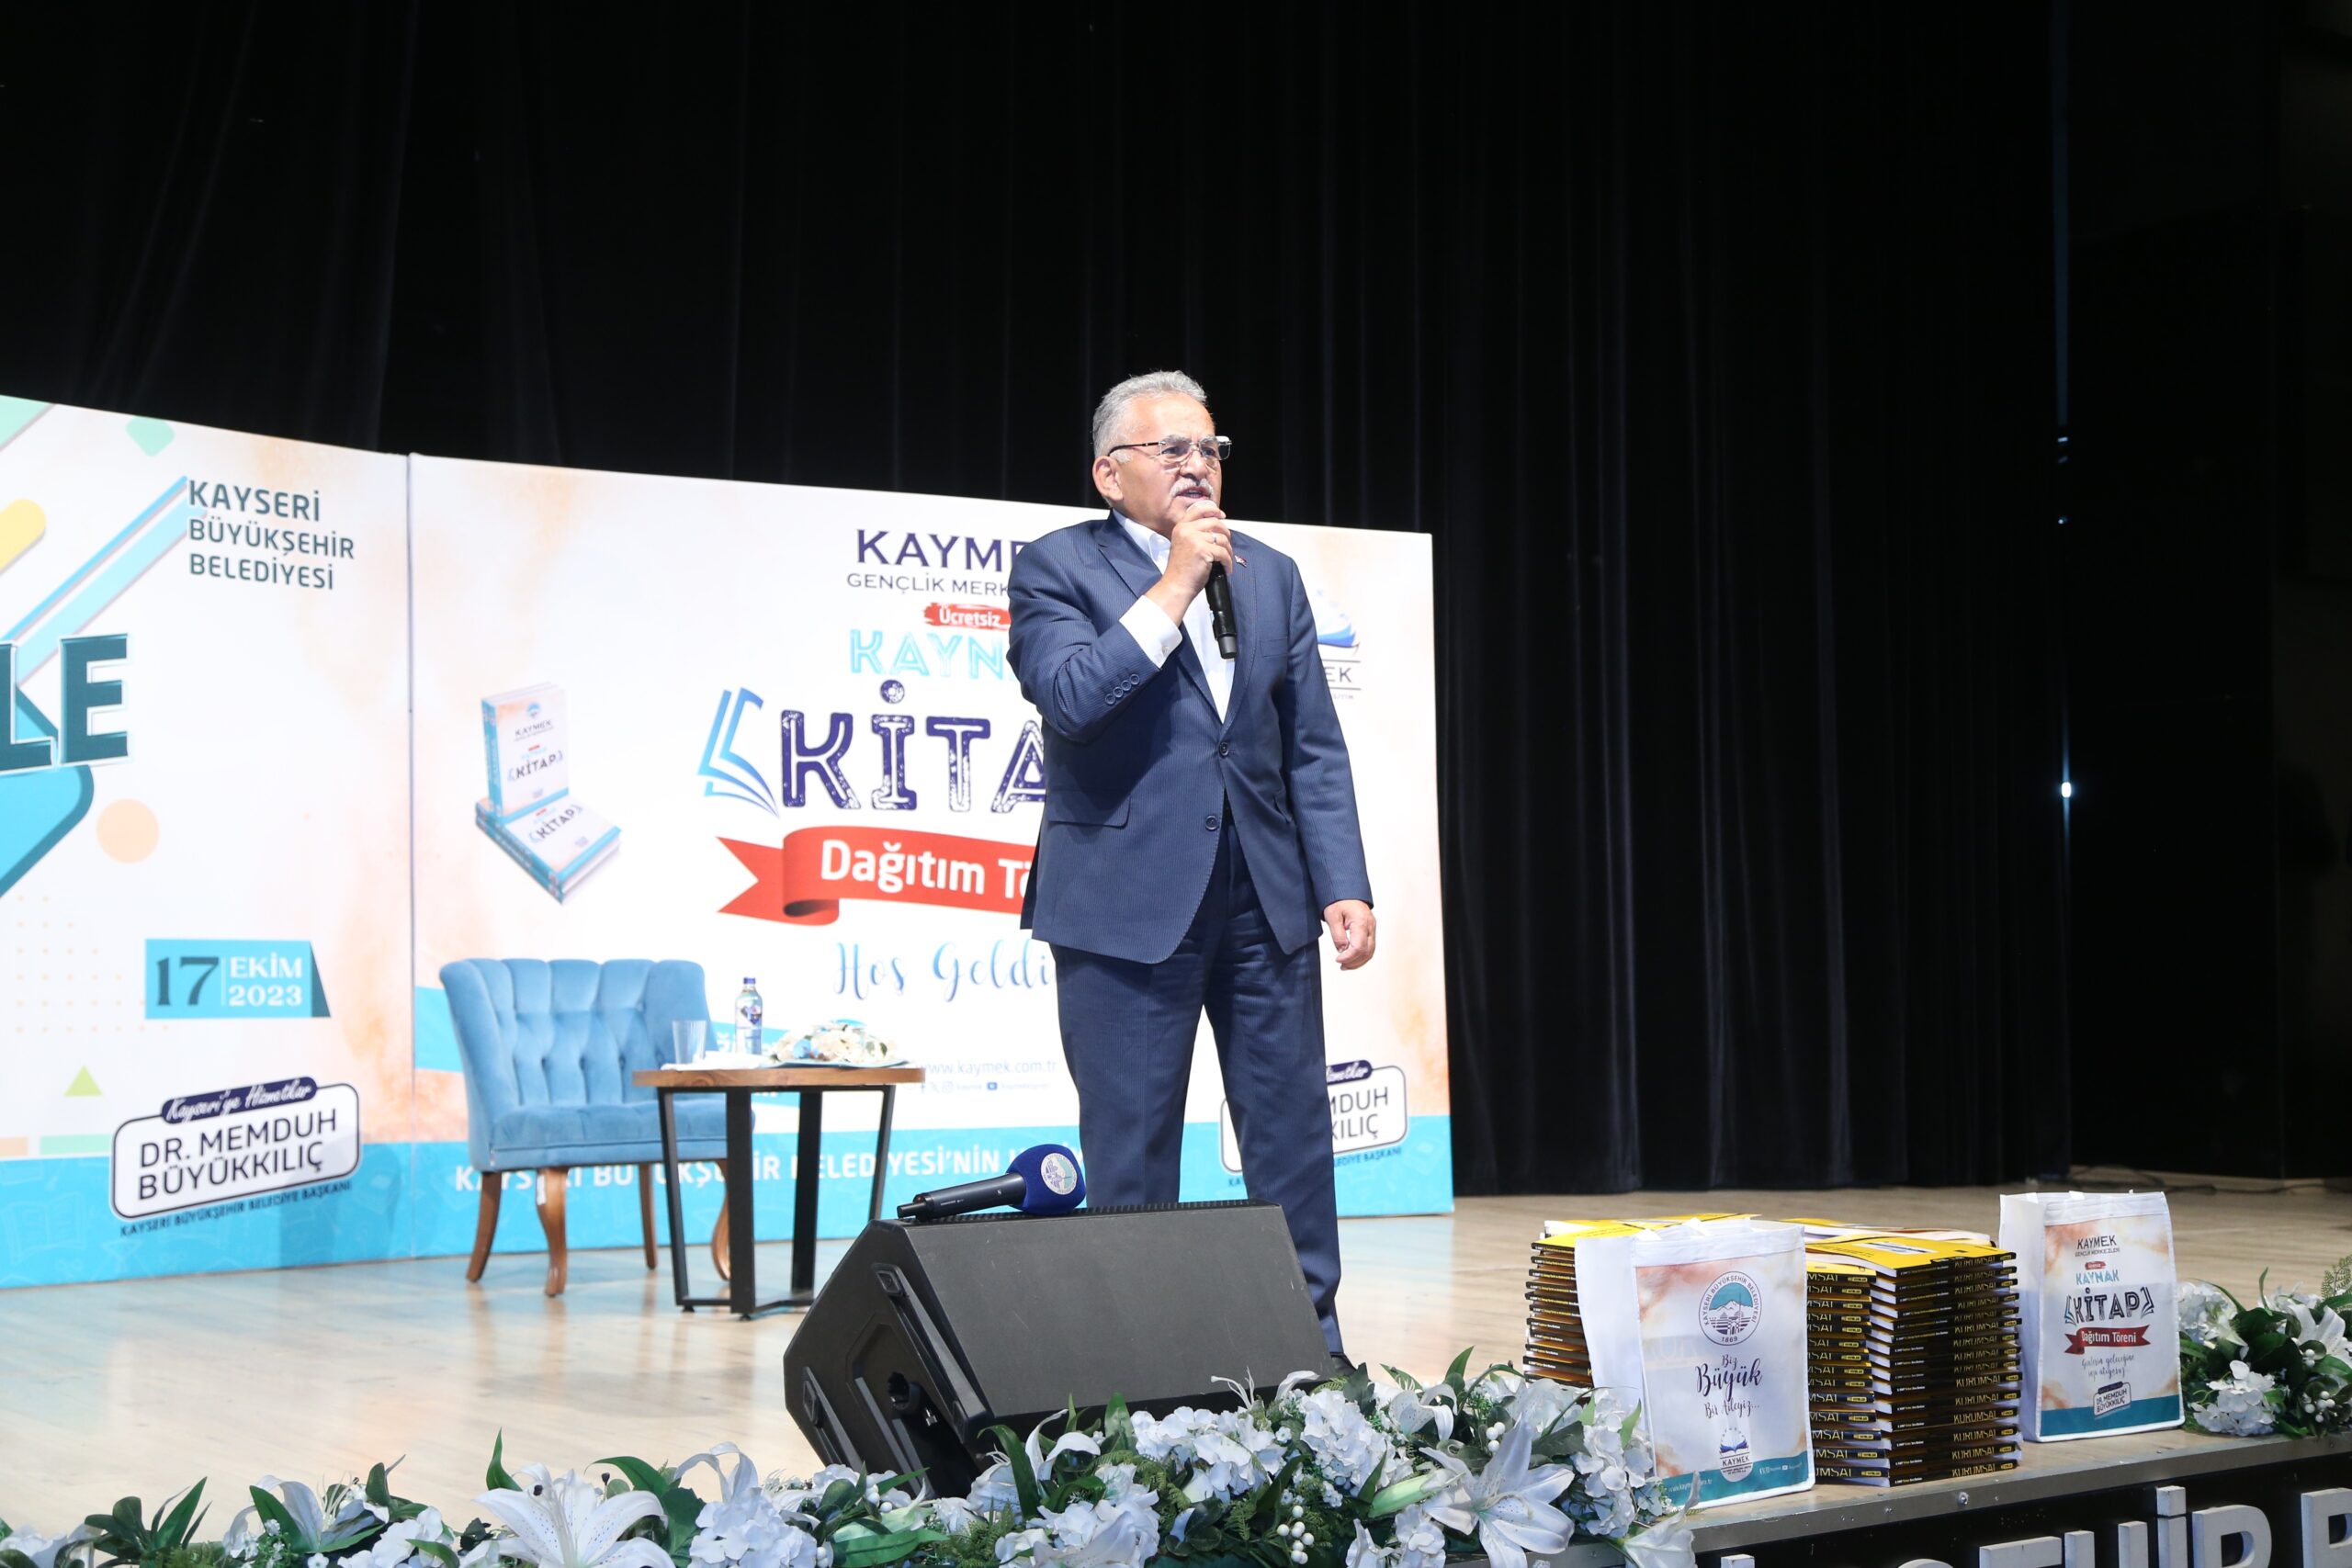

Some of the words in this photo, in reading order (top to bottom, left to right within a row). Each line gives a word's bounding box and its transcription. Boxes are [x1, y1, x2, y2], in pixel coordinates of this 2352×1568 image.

[189, 479, 321, 522] KAYSERİ
[189, 518, 355, 558] BÜYÜKŞEHİR
[189, 553, 334, 590] BELEDİYESİ
[847, 572, 944, 595] GENÇLİK
[951, 581, 1008, 597] MERK
[938, 604, 1001, 628] Ücretsiz
[850, 628, 1004, 680] KAYN
[781, 680, 1046, 814] KİTA
[820, 840, 985, 896] Dağıtım
[156, 956, 220, 1007] 17
[230, 952, 302, 979] EKİM
[933, 938, 1053, 1003] Geldi
[229, 985, 302, 1007] 2023
[141, 1136, 191, 1168] DR.
[200, 1108, 337, 1157] MEMDUH
[139, 1141, 323, 1201] BÜYÜKKILIÇ
[2077, 1235, 2117, 1250] KAYMEK
[2075, 1269, 2120, 1285] KAYNAK
[2073, 1287, 2141, 1324] KİTAP
[2081, 1330, 2109, 1345] Dağıtım
[2112, 1332, 2137, 1343] Töreni
[1695, 1358, 1763, 1402] Büyük
[2103, 1388, 2128, 1402] MEMDUH
[1722, 1455, 1750, 1467] KAYMEK
